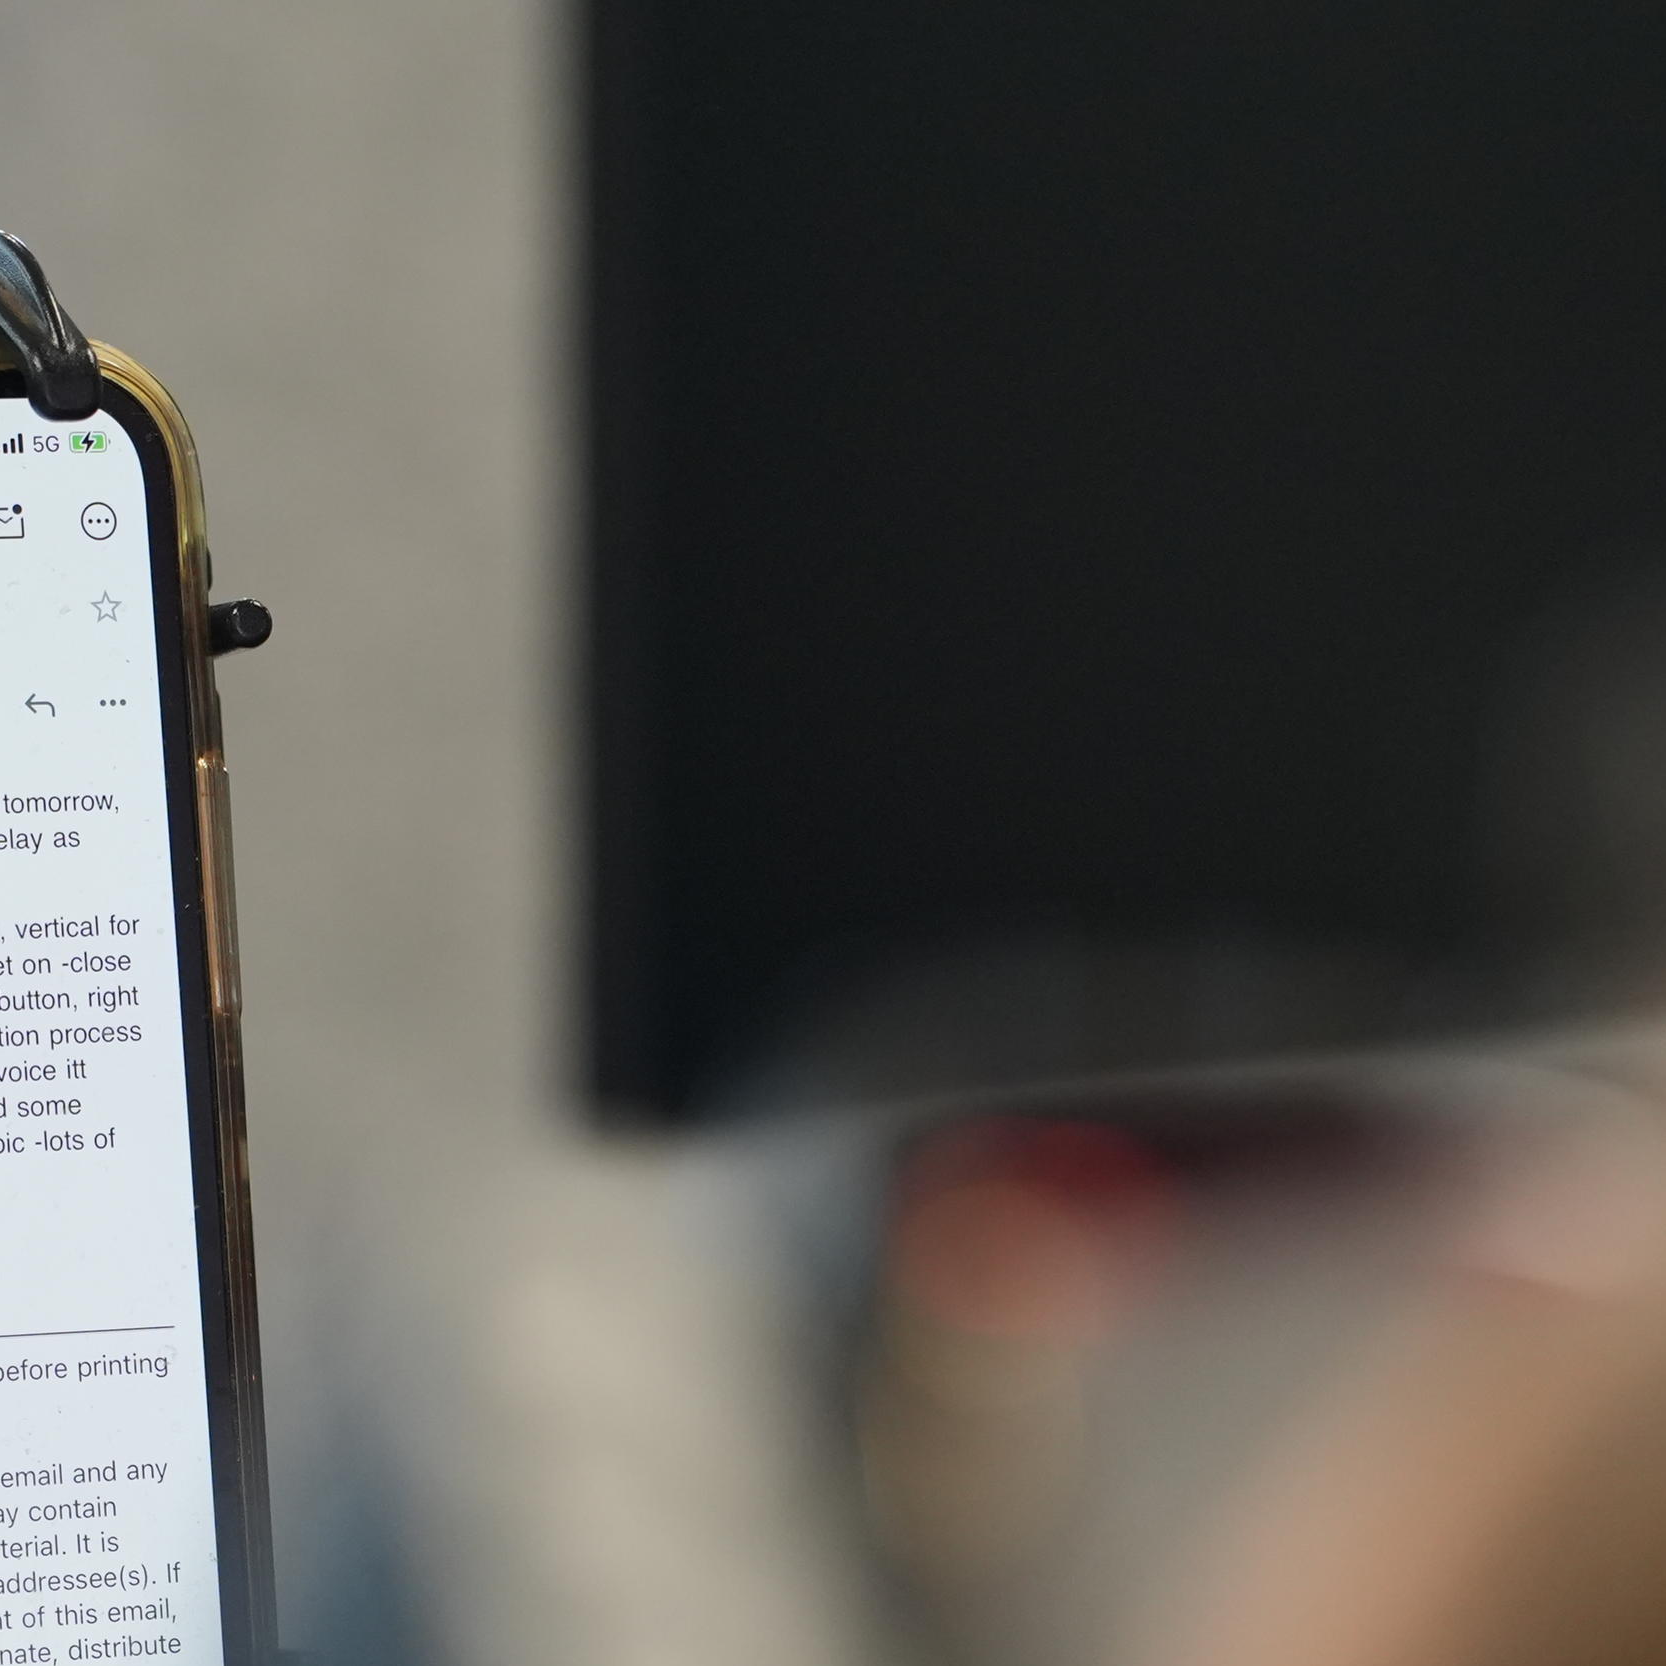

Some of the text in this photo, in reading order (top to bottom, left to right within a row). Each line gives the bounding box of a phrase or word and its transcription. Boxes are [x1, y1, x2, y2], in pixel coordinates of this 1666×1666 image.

[32, 435, 60, 453] 5G
[2, 793, 119, 815] tomorrow,
[52, 830, 81, 849] as
[14, 914, 100, 940] vertical
[108, 913, 141, 936] for
[21, 957, 52, 976] on
[61, 950, 132, 974] -close
[87, 984, 140, 1014] right
[49, 1024, 143, 1051] process
[66, 1057, 88, 1080] itt
[17, 1098, 82, 1118] some
[34, 1129, 85, 1152] -lots
[93, 1126, 116, 1150] of
[77, 1352, 170, 1383] printing
[0, 1462, 64, 1489] email
[72, 1459, 117, 1485] and
[126, 1462, 168, 1485] any
[28, 1495, 117, 1523] contain
[76, 1532, 92, 1555] It
[100, 1530, 120, 1553] is
[166, 1560, 181, 1584] If
[68, 1634, 182, 1661] distribute
